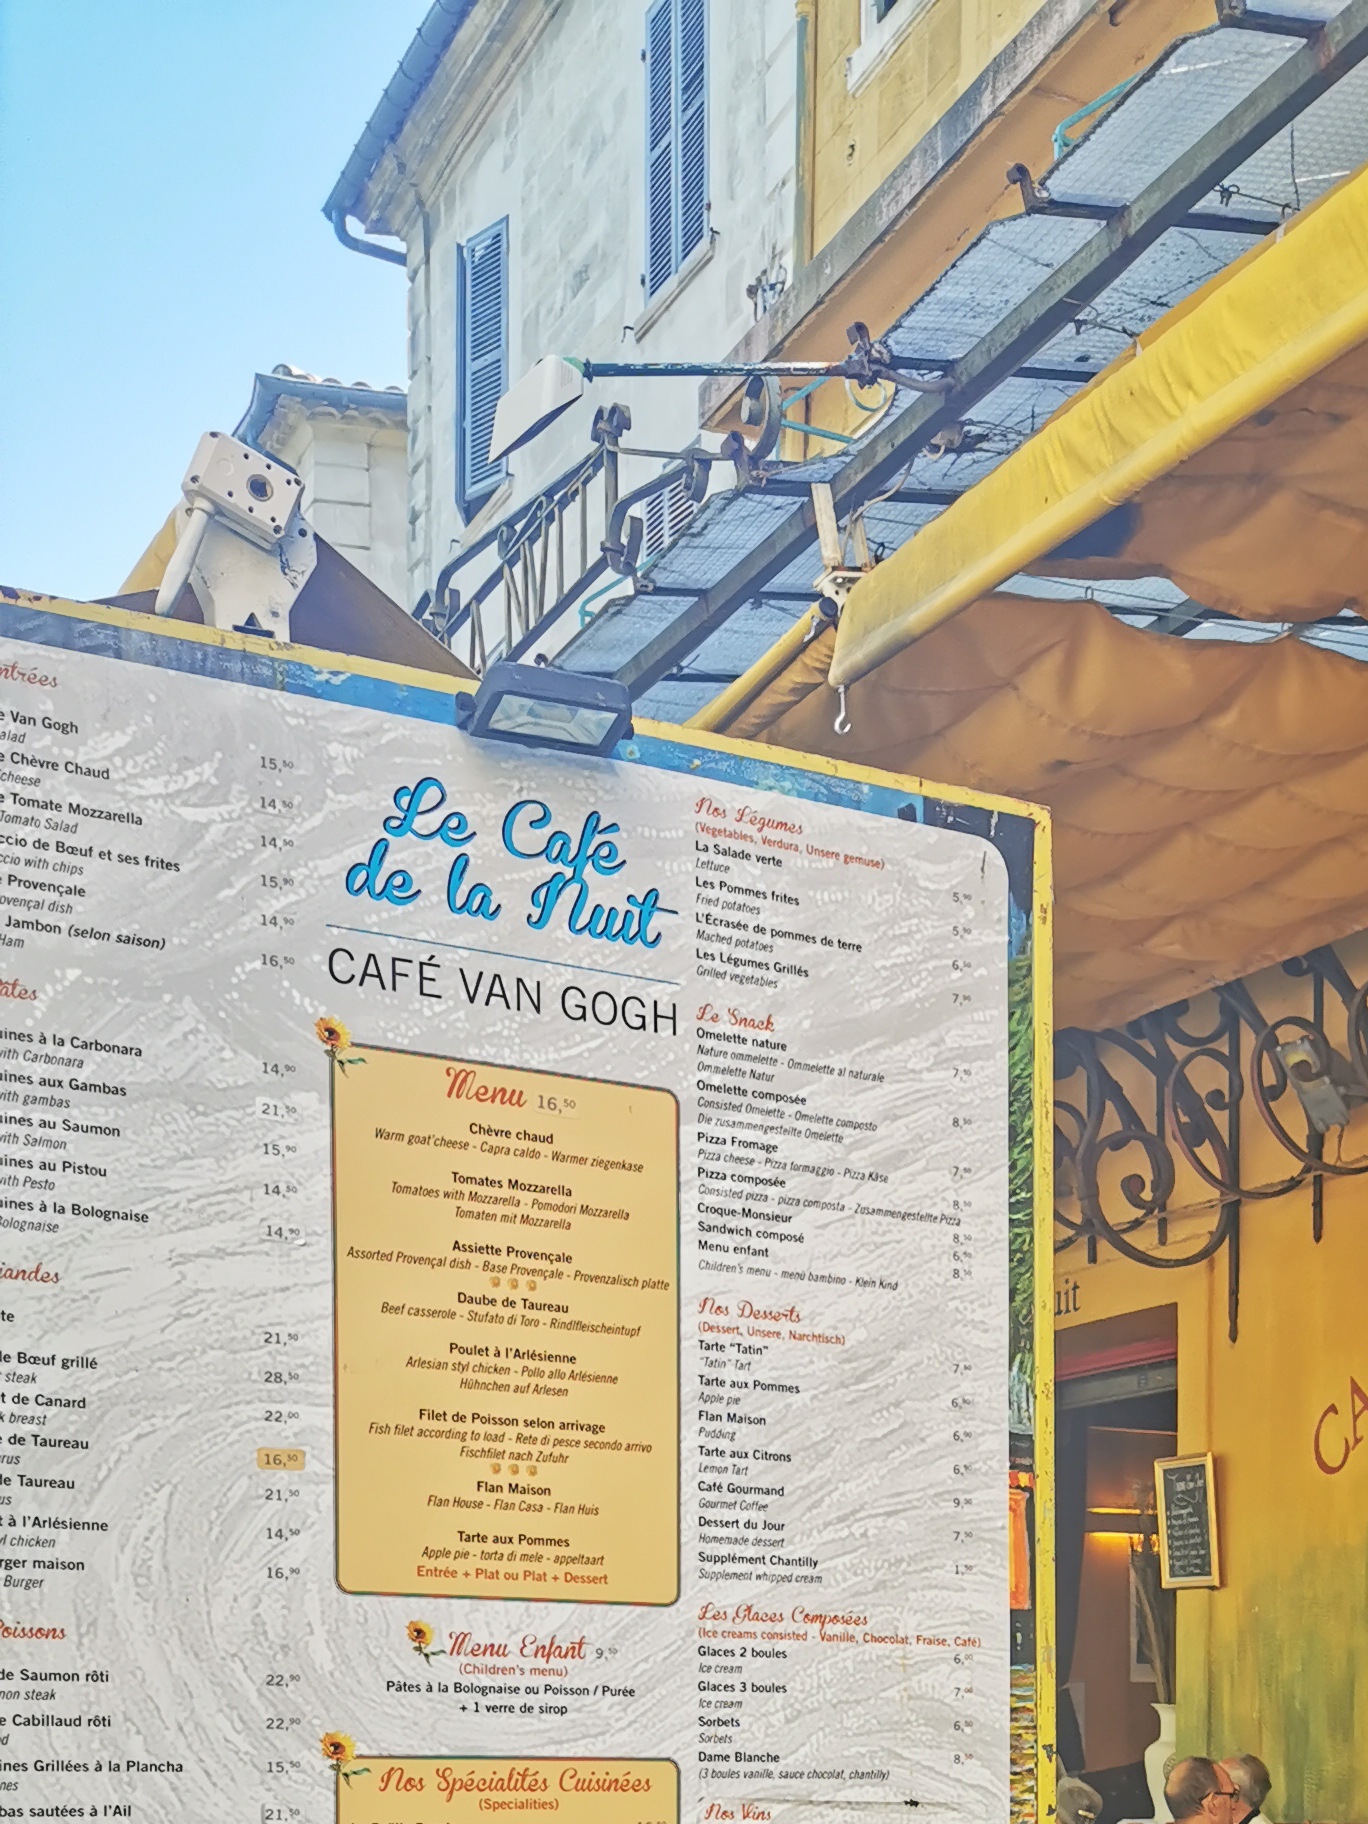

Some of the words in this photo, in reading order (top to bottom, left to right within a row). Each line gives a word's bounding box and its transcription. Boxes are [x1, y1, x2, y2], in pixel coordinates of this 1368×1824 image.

[9, 710, 37, 727] Van
[41, 716, 79, 736] Gogh
[10, 751, 60, 772] Chèvre
[64, 760, 110, 780] Chaud
[9, 791, 63, 813] Tomate
[68, 802, 143, 826] Mozzarella
[694, 796, 727, 819] Nos
[734, 805, 803, 835] Légumes
[383, 777, 477, 847] Le
[502, 800, 627, 884] Café
[32, 837, 50, 852] de
[55, 840, 94, 858] Bœuf
[98, 849, 113, 862] et
[117, 853, 140, 866] ses
[144, 854, 181, 873] frites
[7, 873, 86, 898] Provençale
[346, 838, 421, 905] de
[447, 853, 501, 921] la
[527, 871, 679, 948] Nuit
[4, 914, 62, 935] Jambon
[67, 924, 111, 942] (selon
[115, 933, 166, 951] saison)
[328, 948, 442, 999] CAFÉ
[459, 968, 541, 1014] VAN
[561, 985, 677, 1036] GOGH
[695, 1002, 720, 1024] Le
[727, 1007, 775, 1033] Snack
[696, 1026, 748, 1046] Omelette
[751, 1038, 788, 1052] nature
[445, 1066, 528, 1108] Menu
[469, 1122, 512, 1140] Chèvre
[515, 1129, 554, 1145] chaud
[697, 1131, 727, 1146] Pizza
[731, 1135, 779, 1155] Fromage
[451, 1170, 504, 1189] Tomates
[507, 1178, 573, 1197] Mozzarella
[697, 1202, 793, 1223] Croque-Monsieur
[452, 1239, 502, 1257] Assiette
[506, 1245, 573, 1265] Provençale
[698, 1296, 730, 1317] Nos
[737, 1300, 802, 1324] Desserts
[449, 1342, 490, 1358] Poulet
[493, 1345, 501, 1358] à
[60, 1355, 98, 1371] grillé
[419, 1408, 448, 1423] Filet
[451, 1411, 467, 1424] de
[471, 1412, 519, 1427] Poisson
[522, 1417, 555, 1430] selon
[558, 1419, 606, 1436] arrivage
[476, 1480, 504, 1494] Flan
[508, 1482, 552, 1497] Maison
[456, 1530, 489, 1544] Tarte
[491, 1534, 514, 1545] aux
[518, 1533, 570, 1548] Pommes
[697, 1551, 767, 1566] Supplément
[769, 1554, 819, 1570] Chantilly
[416, 1564, 458, 1579] Entrée
[475, 1567, 500, 1581] Plat
[503, 1571, 520, 1581] ou
[523, 1569, 548, 1583] Plat
[564, 1571, 609, 1585] Dessert
[697, 1601, 728, 1622] Les
[731, 1603, 785, 1625] Glaces
[791, 1606, 868, 1636] Composées
[448, 1631, 509, 1658] Menu
[519, 1634, 588, 1665] Enfant
[697, 1645, 736, 1658] Glaces
[739, 1646, 748, 1658] 2
[751, 1647, 788, 1659] boules
[19, 1668, 80, 1682] Saumon
[85, 1669, 109, 1683] rôti
[529, 1665, 569, 1678] menu)
[386, 1680, 422, 1693] Pâtes
[425, 1681, 434, 1693] à
[437, 1681, 449, 1694] la
[453, 1681, 521, 1697] Bolognaise
[524, 1685, 540, 1695] ou
[543, 1683, 590, 1697] Poisson
[601, 1685, 636, 1698] Purée
[697, 1715, 741, 1728] Sorbets
[33, 1759, 90, 1773] Grillées
[93, 1760, 103, 1773] à
[108, 1760, 121, 1773] la
[126, 1760, 184, 1773] Plancha
[698, 1751, 731, 1763] Dame
[734, 1751, 780, 1763] Blanche
[378, 1766, 426, 1793] Nos
[435, 1766, 550, 1803] Spécialités
[558, 1767, 652, 1793] Cuisinées
[478, 1797, 560, 1813] (Specialities)
[704, 1802, 735, 1821] Nos
[741, 1802, 771, 1821] Vins
